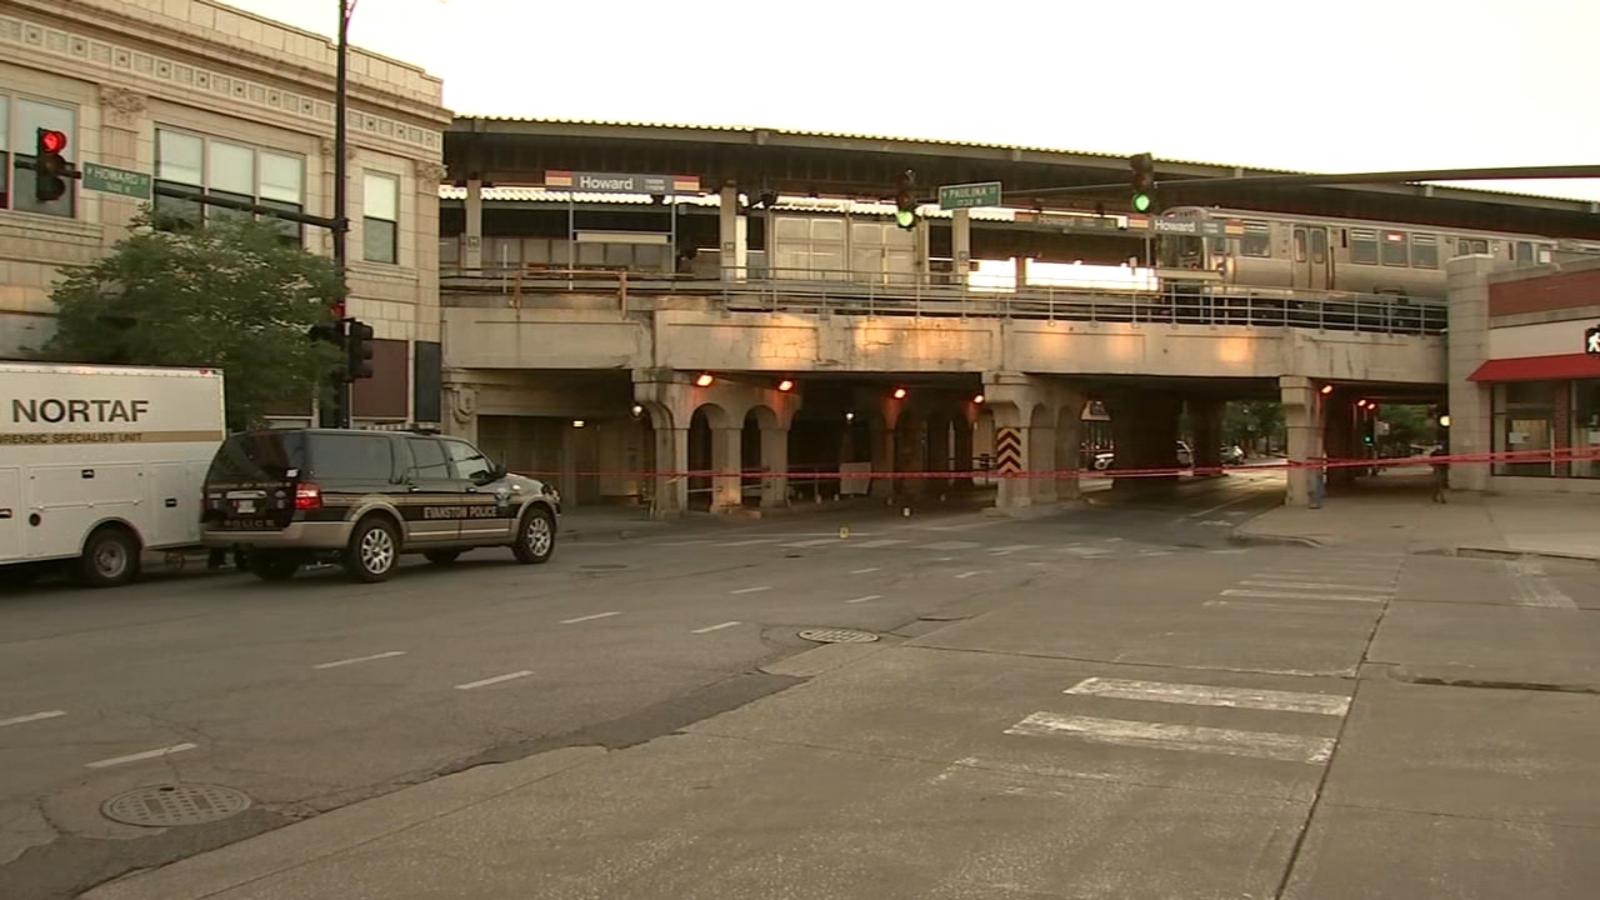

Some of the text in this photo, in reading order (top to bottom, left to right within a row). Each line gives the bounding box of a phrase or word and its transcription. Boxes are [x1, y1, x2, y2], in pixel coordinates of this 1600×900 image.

[94, 168, 138, 185] HOWARD
[579, 176, 633, 190] Howard
[949, 187, 987, 199] PAULINA
[1154, 219, 1195, 232] Howard
[12, 399, 149, 423] NORTAF
[53, 432, 115, 444] SPECIALIST
[119, 432, 143, 442] UNIT
[424, 505, 497, 519] EVANSTON POLICE
